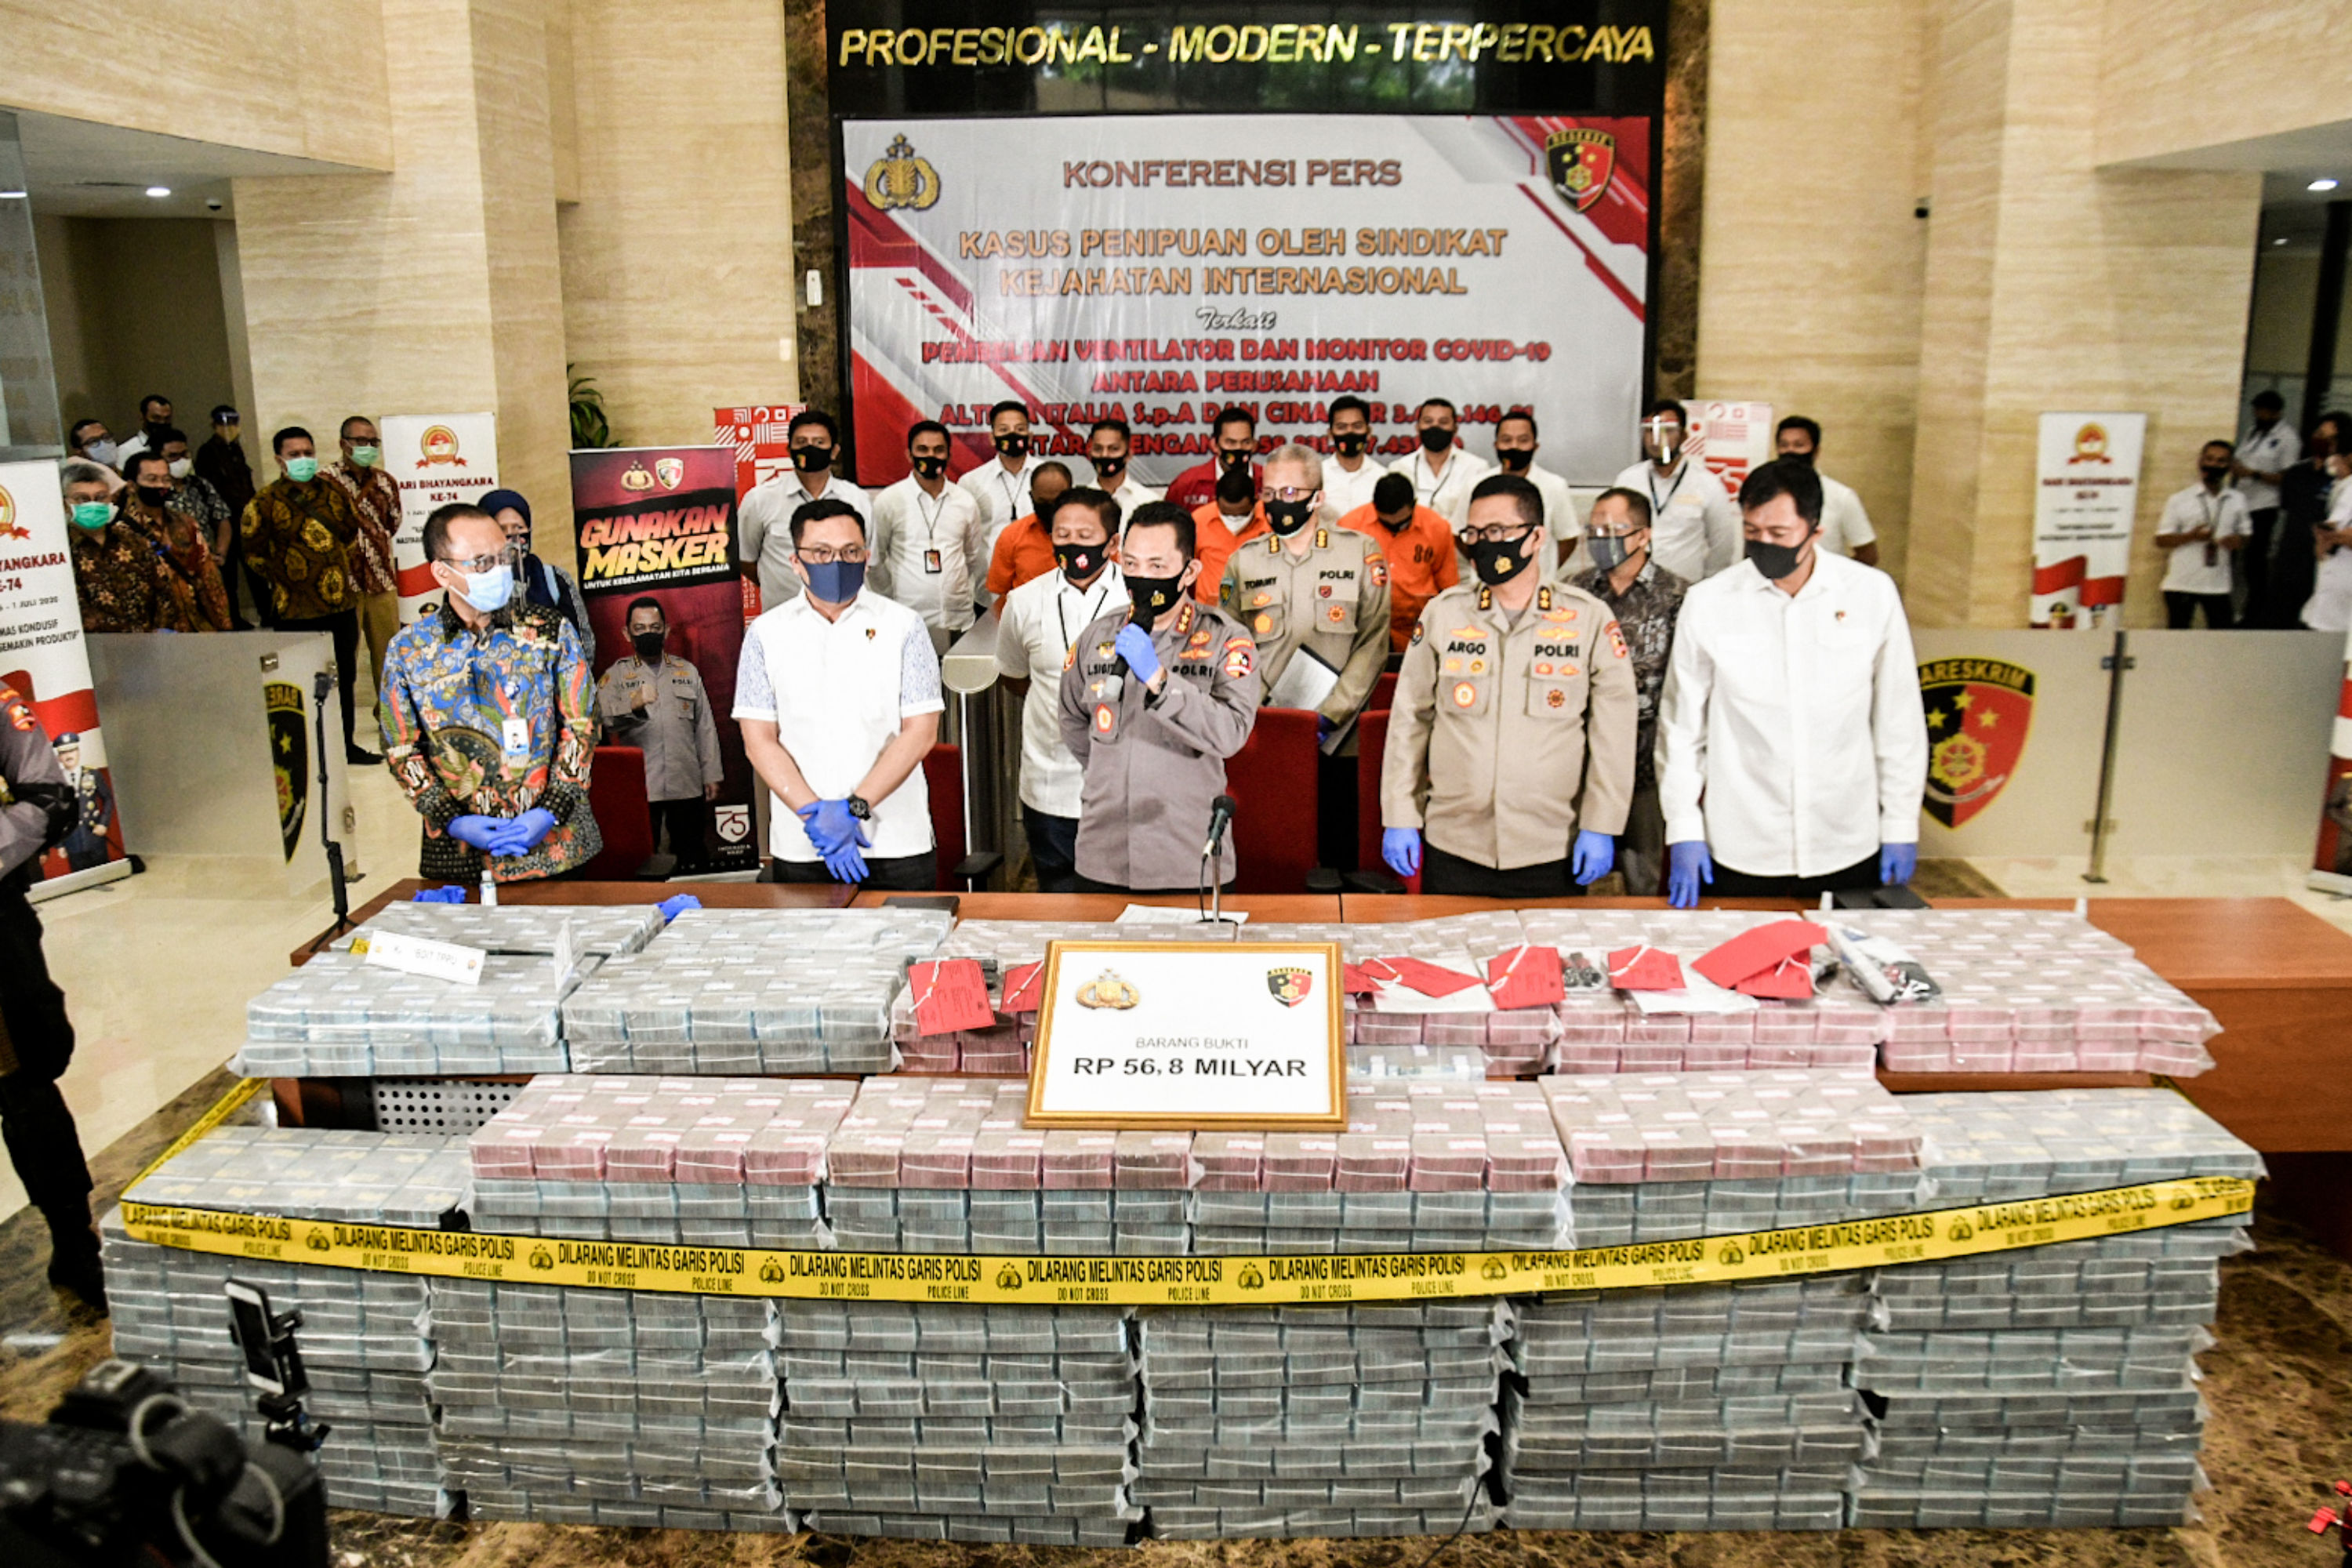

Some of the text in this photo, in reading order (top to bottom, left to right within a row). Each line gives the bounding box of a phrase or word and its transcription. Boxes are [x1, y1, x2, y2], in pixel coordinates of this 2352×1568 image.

[839, 25, 1132, 67] PROFESIONAL
[1168, 24, 1358, 63] MODERN
[1388, 23, 1654, 64] TERPERCAYA
[1063, 159, 1403, 187] KONFERENSI PERS
[960, 227, 1508, 260] KASUS PENIPUAN OLEH SINDIKAT
[1000, 266, 1468, 297] KEJAHATAN INTERNASIONAL
[1196, 307, 1277, 331] Terkait
[922, 339, 1552, 363] PEMBELIAN VENTILATOR DAN MONITOR COVID-19
[1091, 370, 1380, 394] ANTARA PERUSAHAAN
[1133, 402, 1195, 427] S.p.A
[1128, 433, 1214, 456] ENGAN
[398, 477, 494, 490] ARI BHAYANGKARA
[430, 492, 458, 502] KE-74
[581, 503, 731, 548] GUNAKAN
[583, 532, 730, 581] MASKER
[583, 564, 730, 590] UNTUK KESELAMATAN KITA BERSAMA
[1243, 576, 1278, 590] TOMMY
[1319, 570, 1355, 580] POLRI
[18, 619, 58, 633] KONDUSIF
[1447, 641, 1486, 655] ARGO
[1534, 644, 1580, 658] POLRI
[1172, 665, 1214, 678] POLRI
[1920, 659, 2027, 689] ARESKRIM
[1135, 1036, 1249, 1050] BARANG BUKTI
[1073, 1058, 1115, 1075] RP
[1195, 1059, 1307, 1076] MILYAR
[334, 1227, 514, 1260] DILARANG MELINTAS GARIS POLISI
[1749, 1216, 1934, 1255] DILARANG MELINTAS GARIS POLISI
[362, 1253, 408, 1269] DO NOT CROSS
[558, 1243, 744, 1274] DILARANG MELINTAS GARIS POLISI
[1512, 1241, 1704, 1272] DILARANG MELINTAS GARIS POLISI
[463, 1262, 503, 1277] POLICE LINE
[790, 1254, 982, 1281] DILARANG MELINTAS GARIS POLISI
[1028, 1260, 1222, 1283] DILARANG MELINTAS GARIS POLISI
[1269, 1255, 1465, 1280] DILARANG MELINTAS GARIS POLISI
[586, 1270, 636, 1287] DO NOT CROSS
[691, 1276, 732, 1292] POLICE LINE
[1411, 1280, 1454, 1295] POLICE LINE
[819, 1282, 870, 1297] DO NOT CROSS
[927, 1285, 969, 1299] POLICE LINE
[1058, 1287, 1109, 1301] DO NOT CROSS
[1168, 1287, 1210, 1301] POLICE LINE
[1301, 1284, 1352, 1299] DO NOT CROSS
